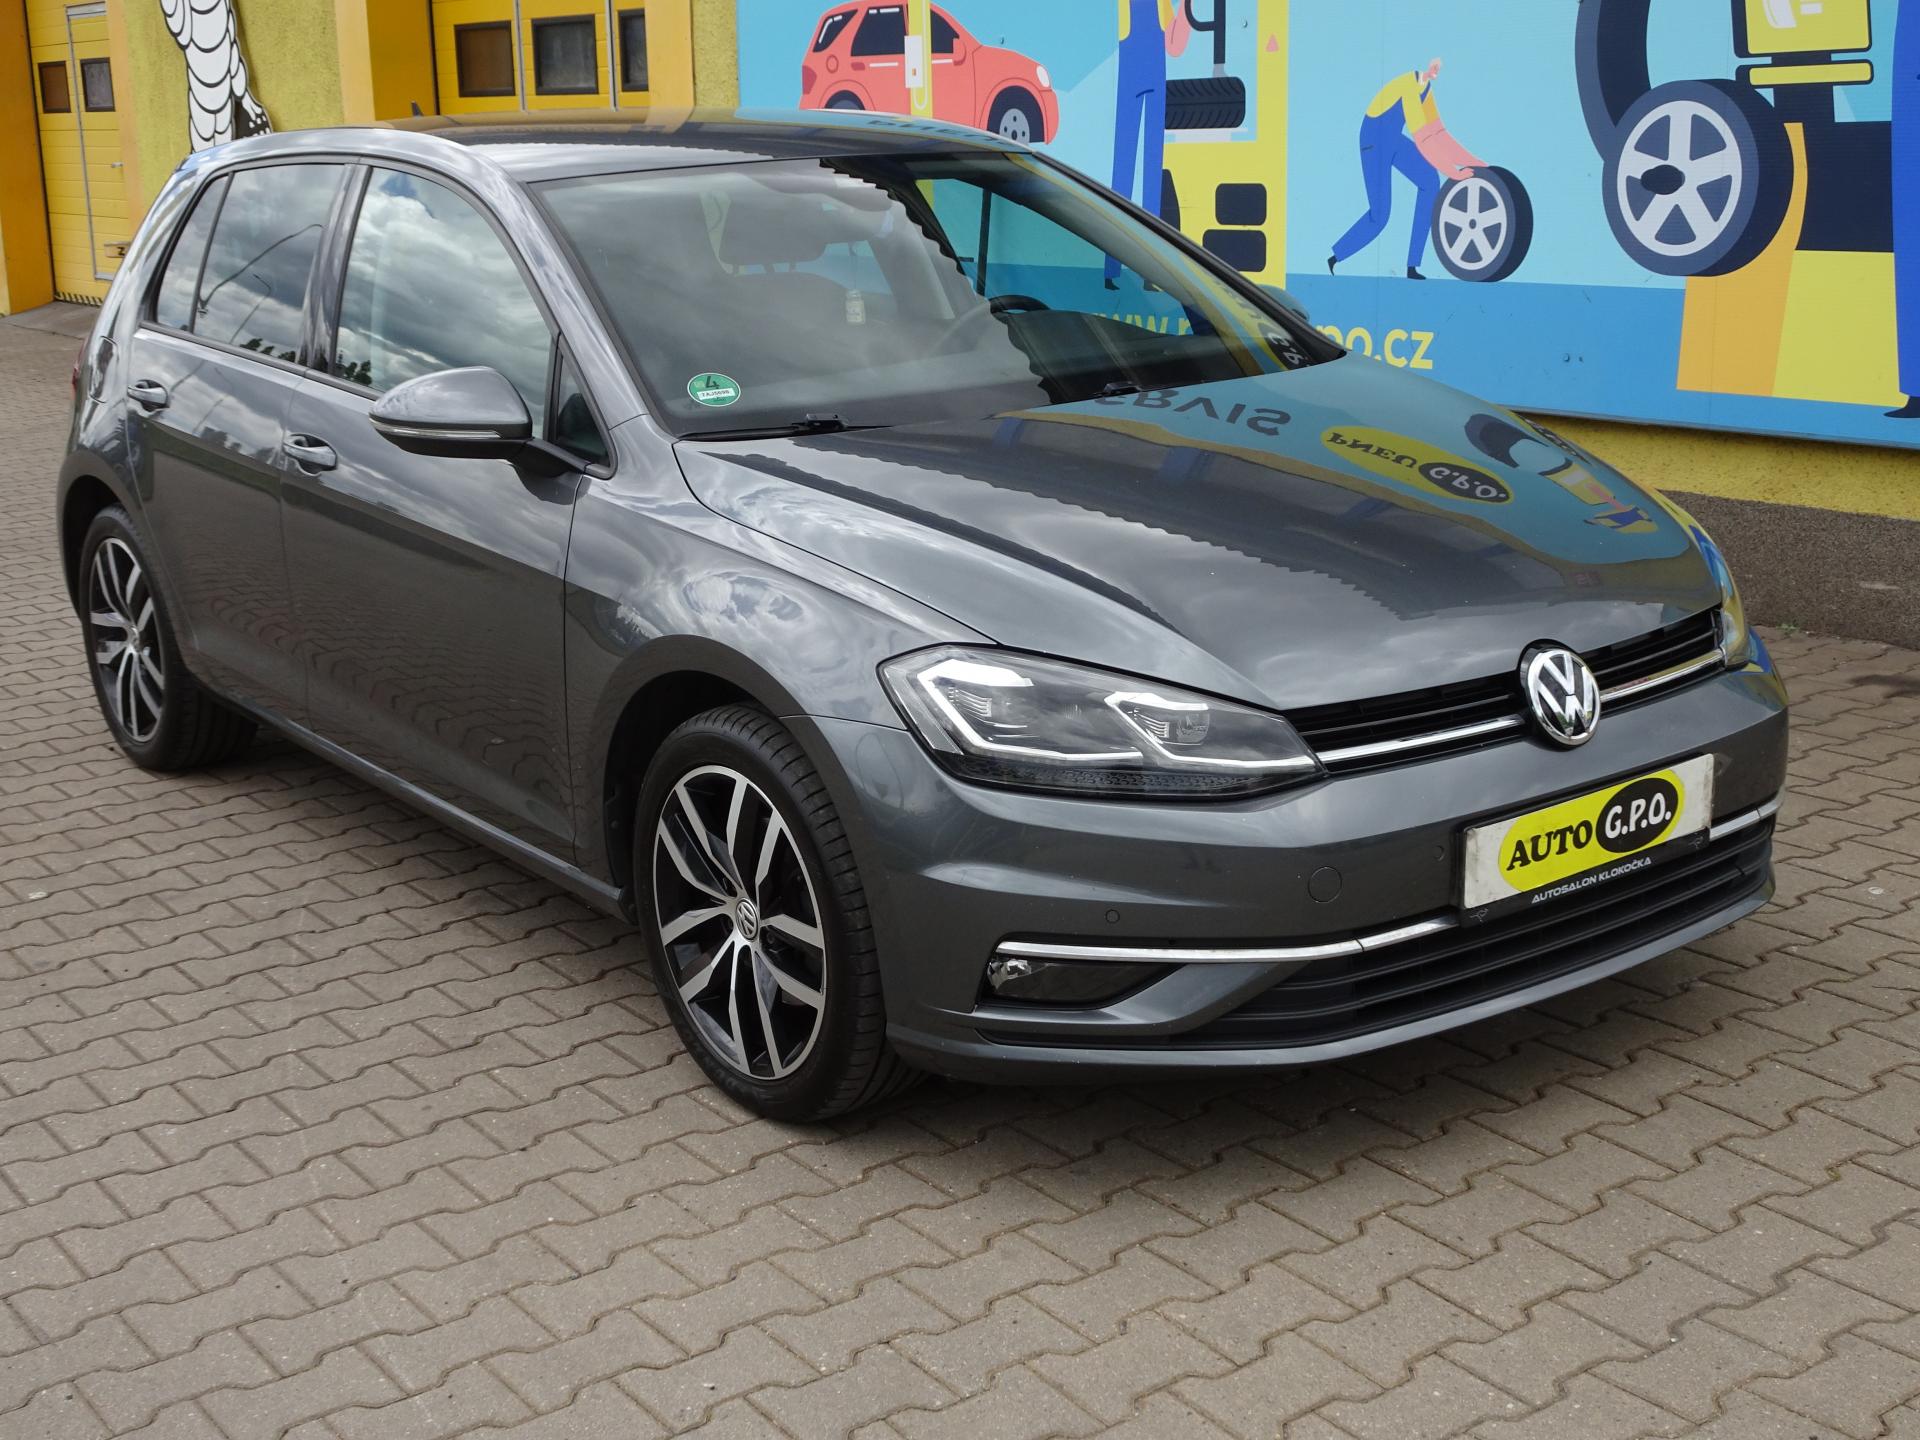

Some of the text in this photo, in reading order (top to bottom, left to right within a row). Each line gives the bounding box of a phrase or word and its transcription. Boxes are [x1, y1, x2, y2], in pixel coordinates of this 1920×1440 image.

[1506, 792, 1672, 871] AUTO G.P.O.
[1531, 855, 1652, 905] AUTOSALON KLOKOČKA
